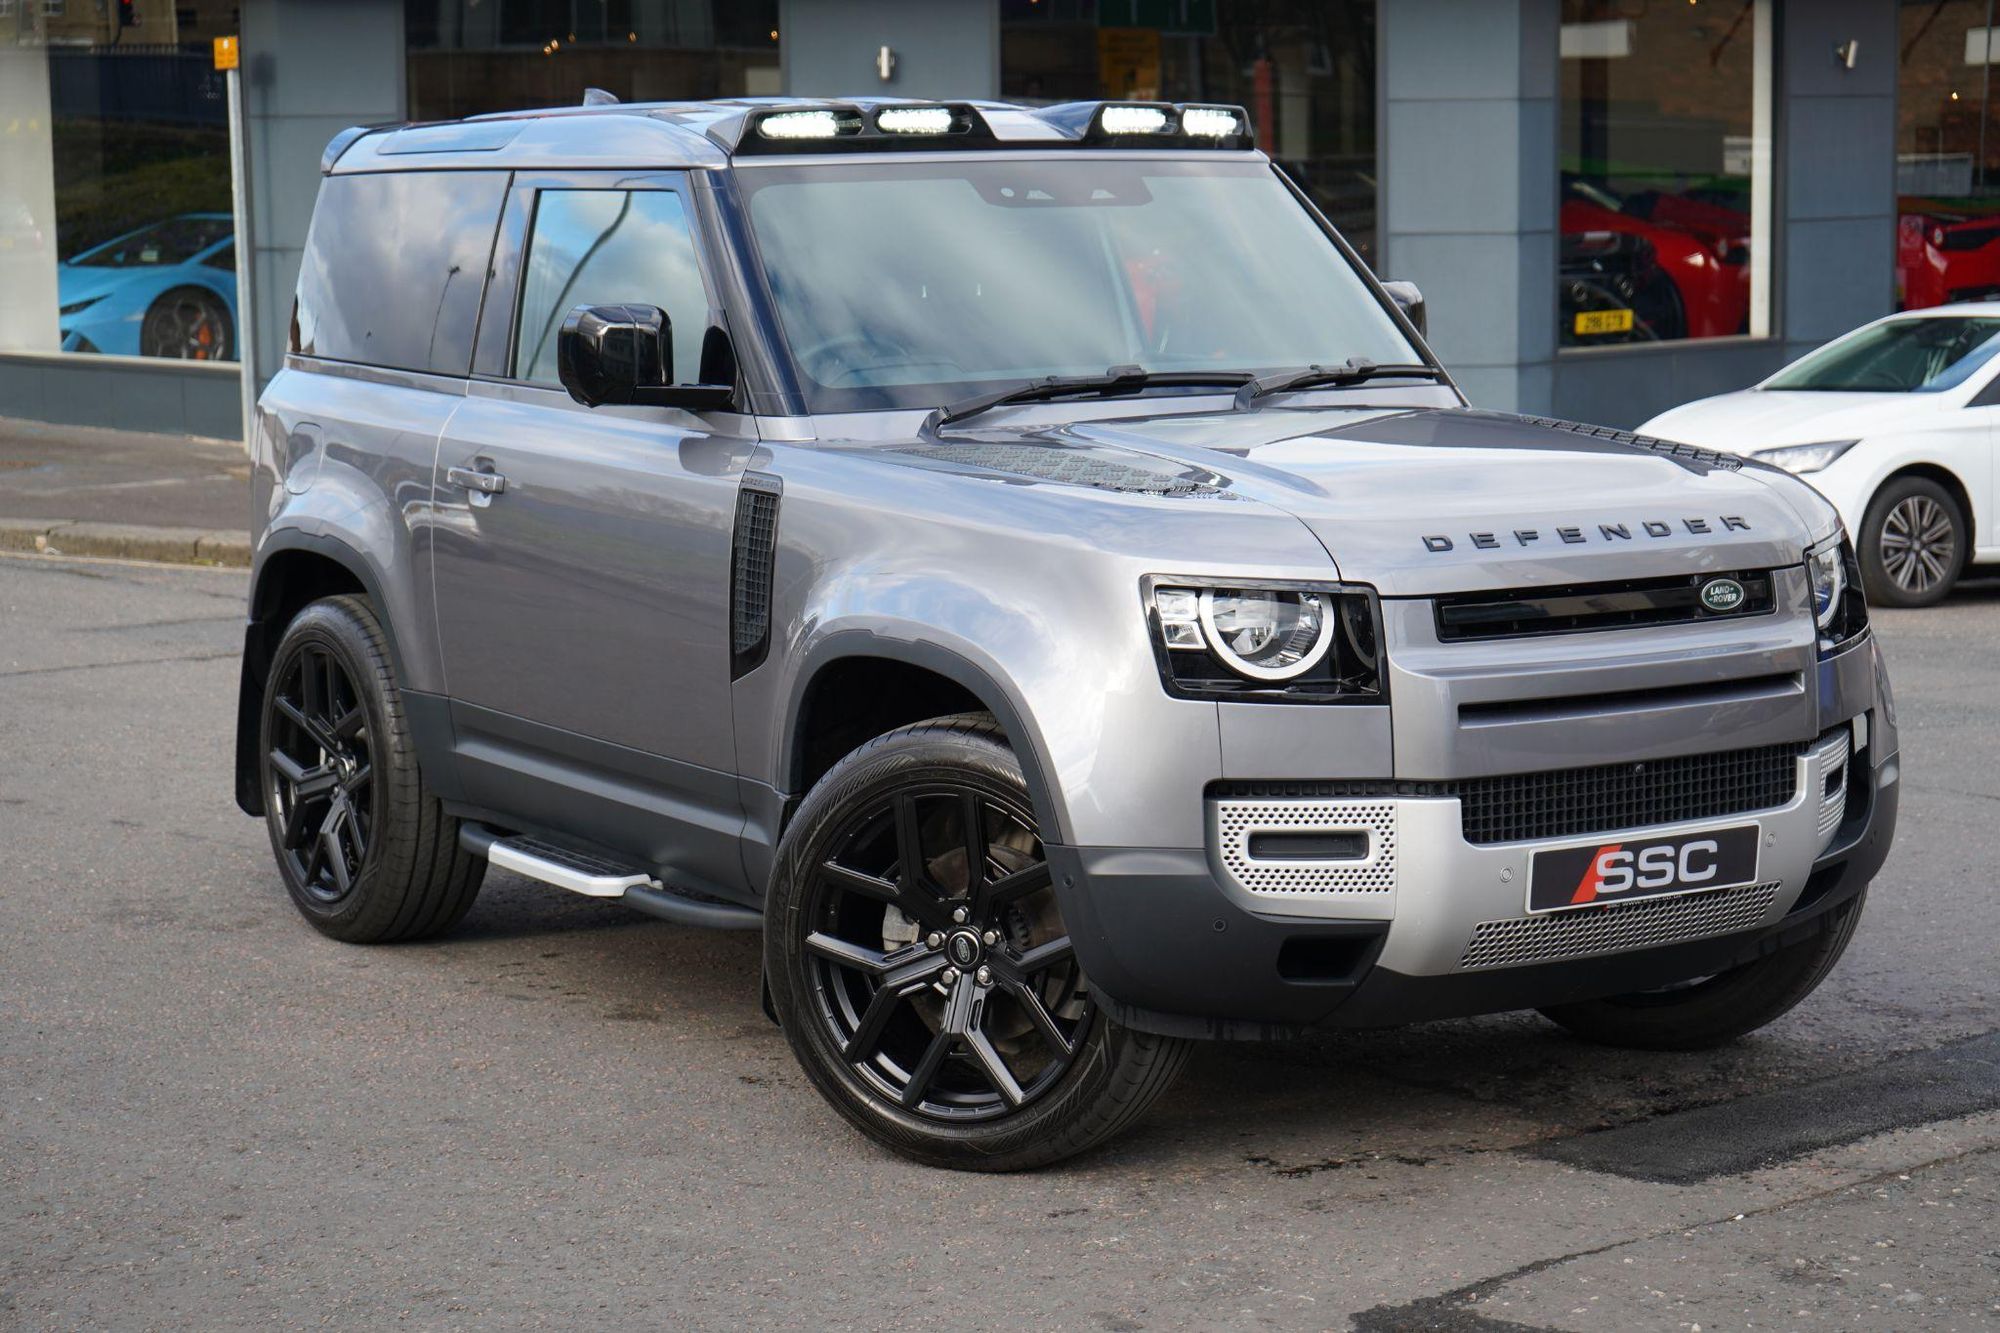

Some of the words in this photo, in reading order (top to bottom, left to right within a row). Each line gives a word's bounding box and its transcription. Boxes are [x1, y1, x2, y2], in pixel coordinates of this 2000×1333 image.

[1422, 514, 1751, 552] DEFENDER
[1710, 585, 1730, 595] LAND
[1713, 593, 1737, 603] ROVER
[1595, 840, 1718, 894] SSC
